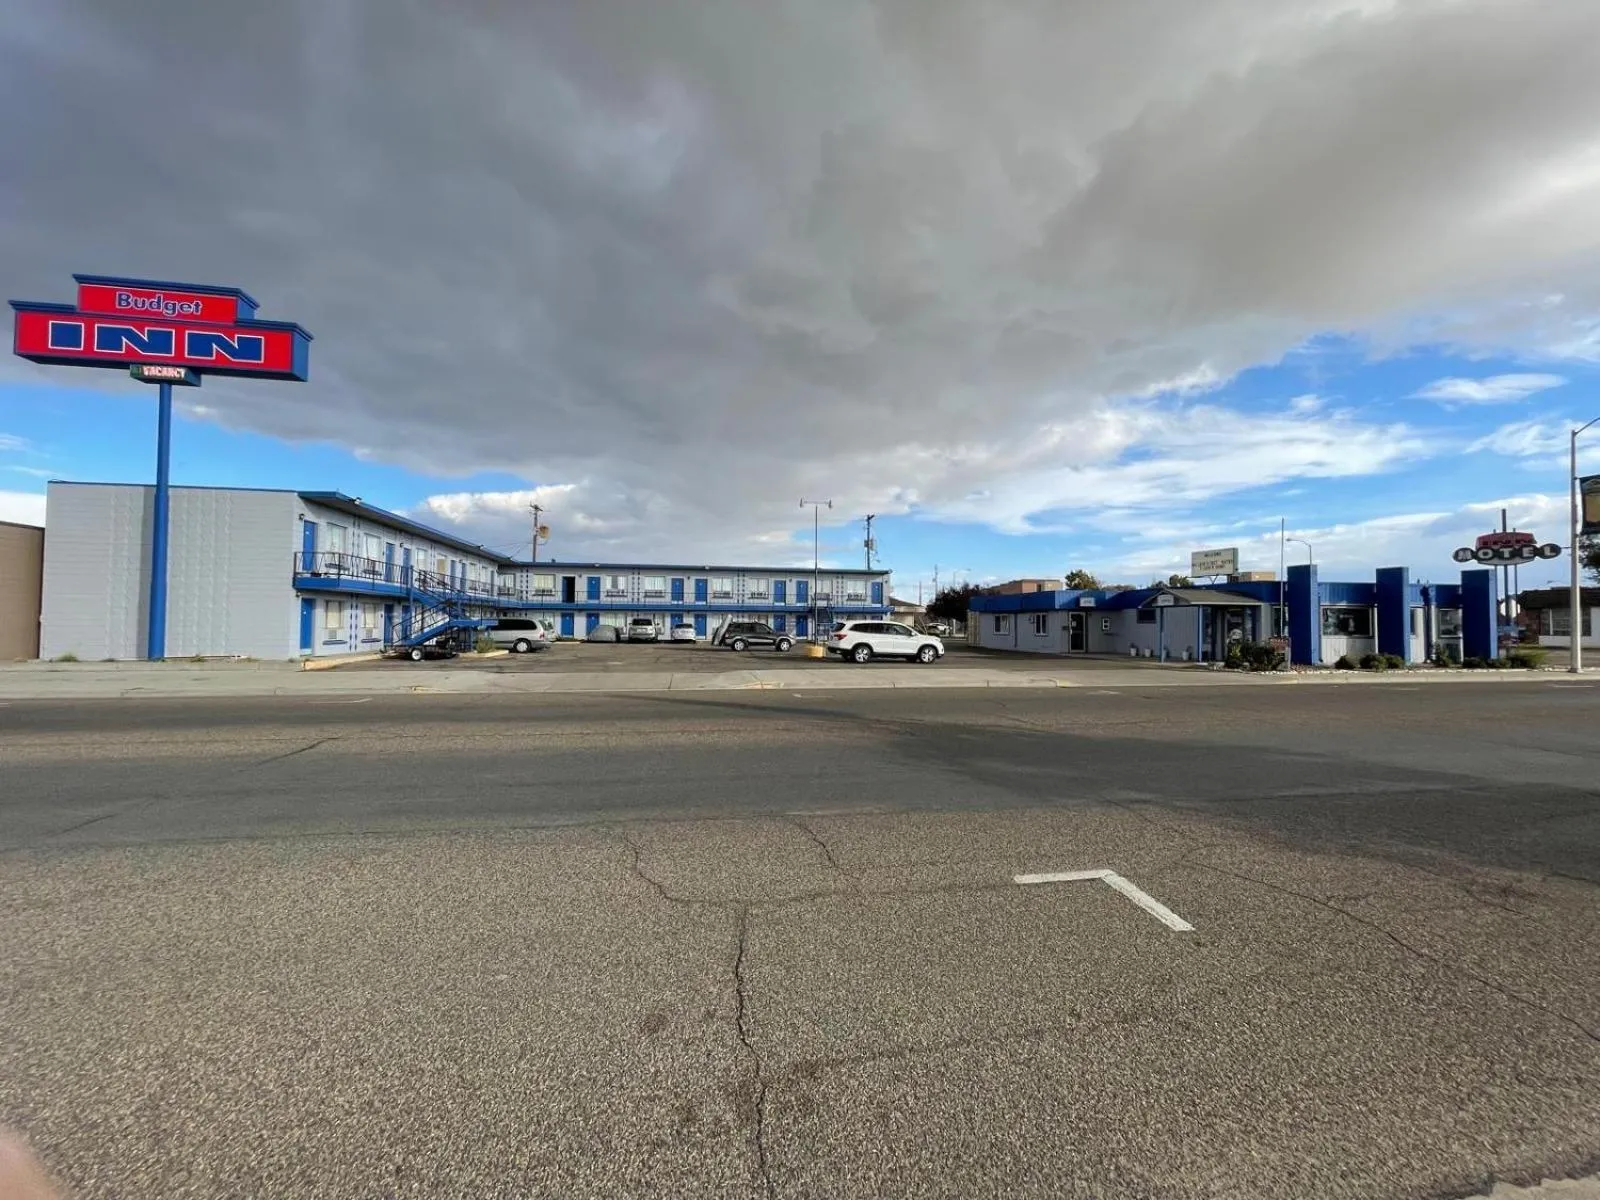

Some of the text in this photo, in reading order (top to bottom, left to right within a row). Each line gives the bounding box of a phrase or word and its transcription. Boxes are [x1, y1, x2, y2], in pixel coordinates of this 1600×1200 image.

[116, 291, 202, 315] Budget
[49, 320, 264, 362] INN
[143, 365, 186, 379] VACANCY
[1458, 546, 1556, 560] MOTEL
